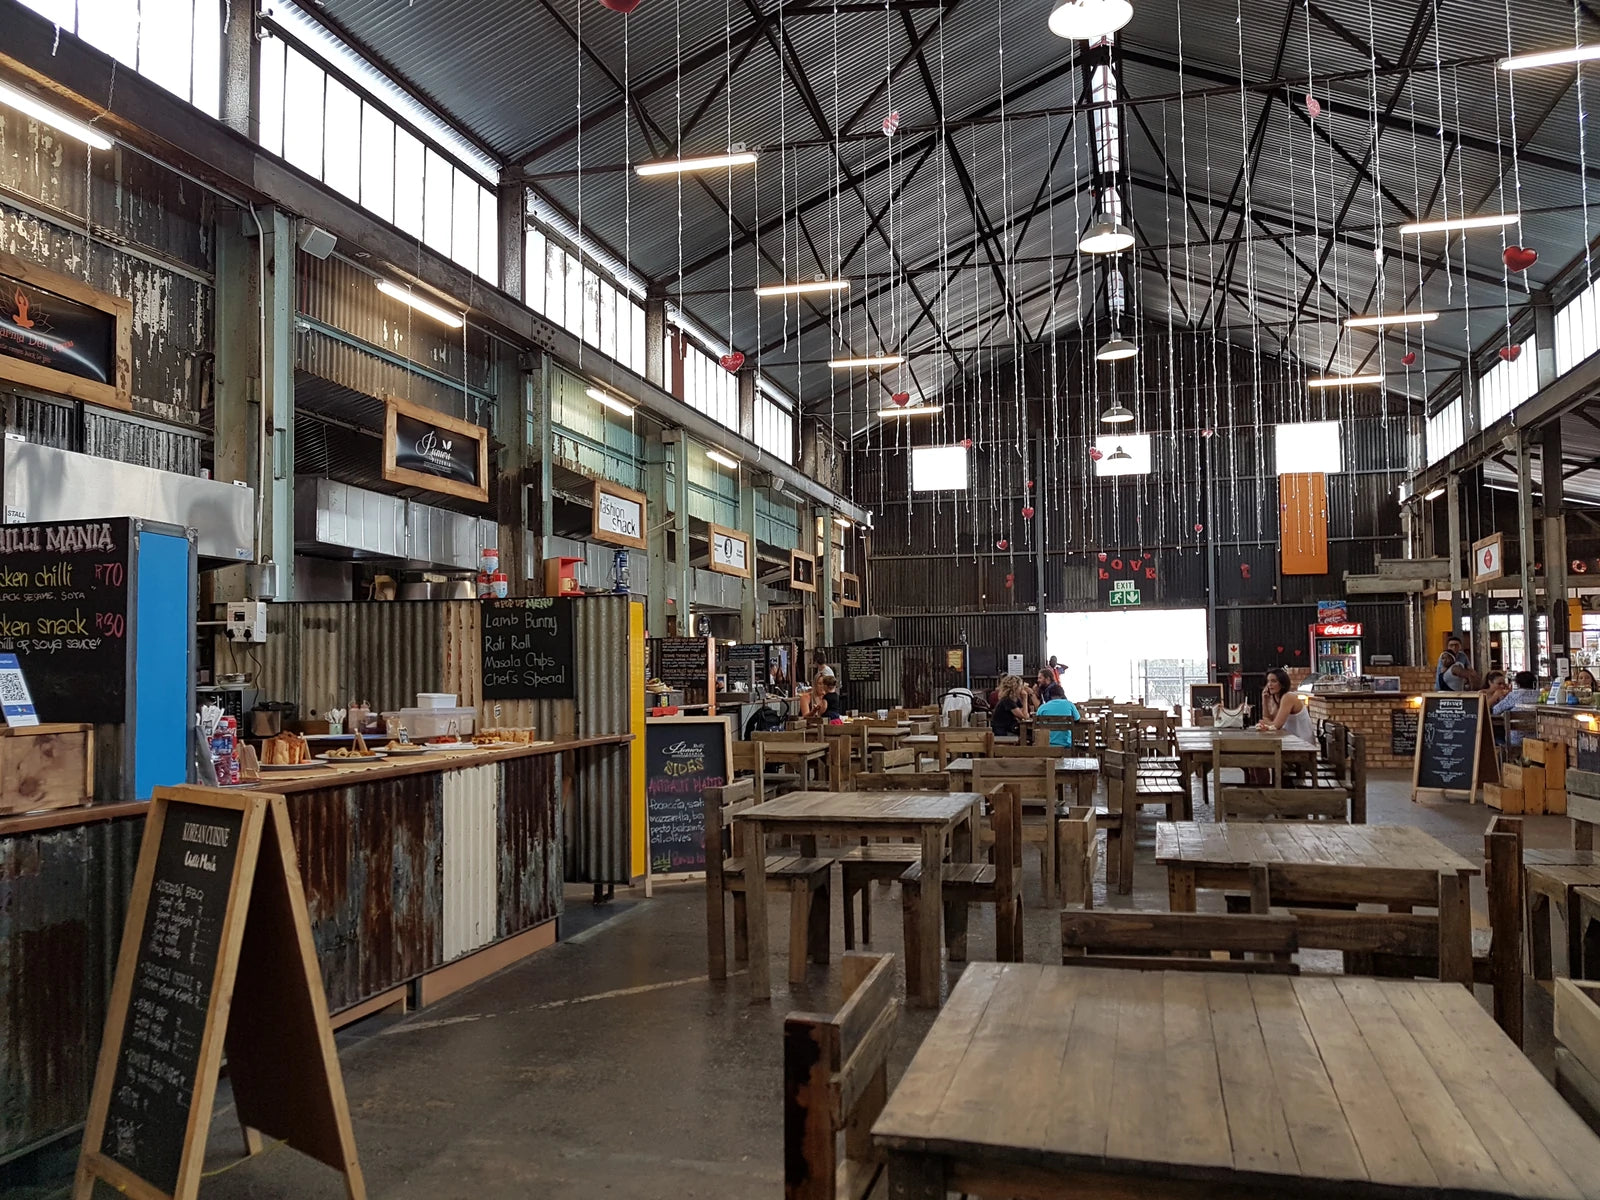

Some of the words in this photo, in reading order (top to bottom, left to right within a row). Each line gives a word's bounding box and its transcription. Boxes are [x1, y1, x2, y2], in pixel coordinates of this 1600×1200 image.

[7, 510, 26, 519] STALL
[612, 517, 637, 536] shack
[45, 523, 116, 554] MANIA
[35, 562, 72, 588] chilli
[95, 562, 123, 587] R70
[1116, 582, 1134, 590] EXIT
[37, 608, 88, 635] snack
[485, 613, 519, 628] Lamb
[525, 611, 558, 636] Bunny
[32, 639, 62, 654] soya
[485, 635, 505, 652] Roti
[511, 634, 531, 650] Roll
[484, 653, 521, 669] Masala
[525, 652, 556, 671] Chips
[523, 665, 565, 687] Special
[664, 758, 704, 776] SIDES
